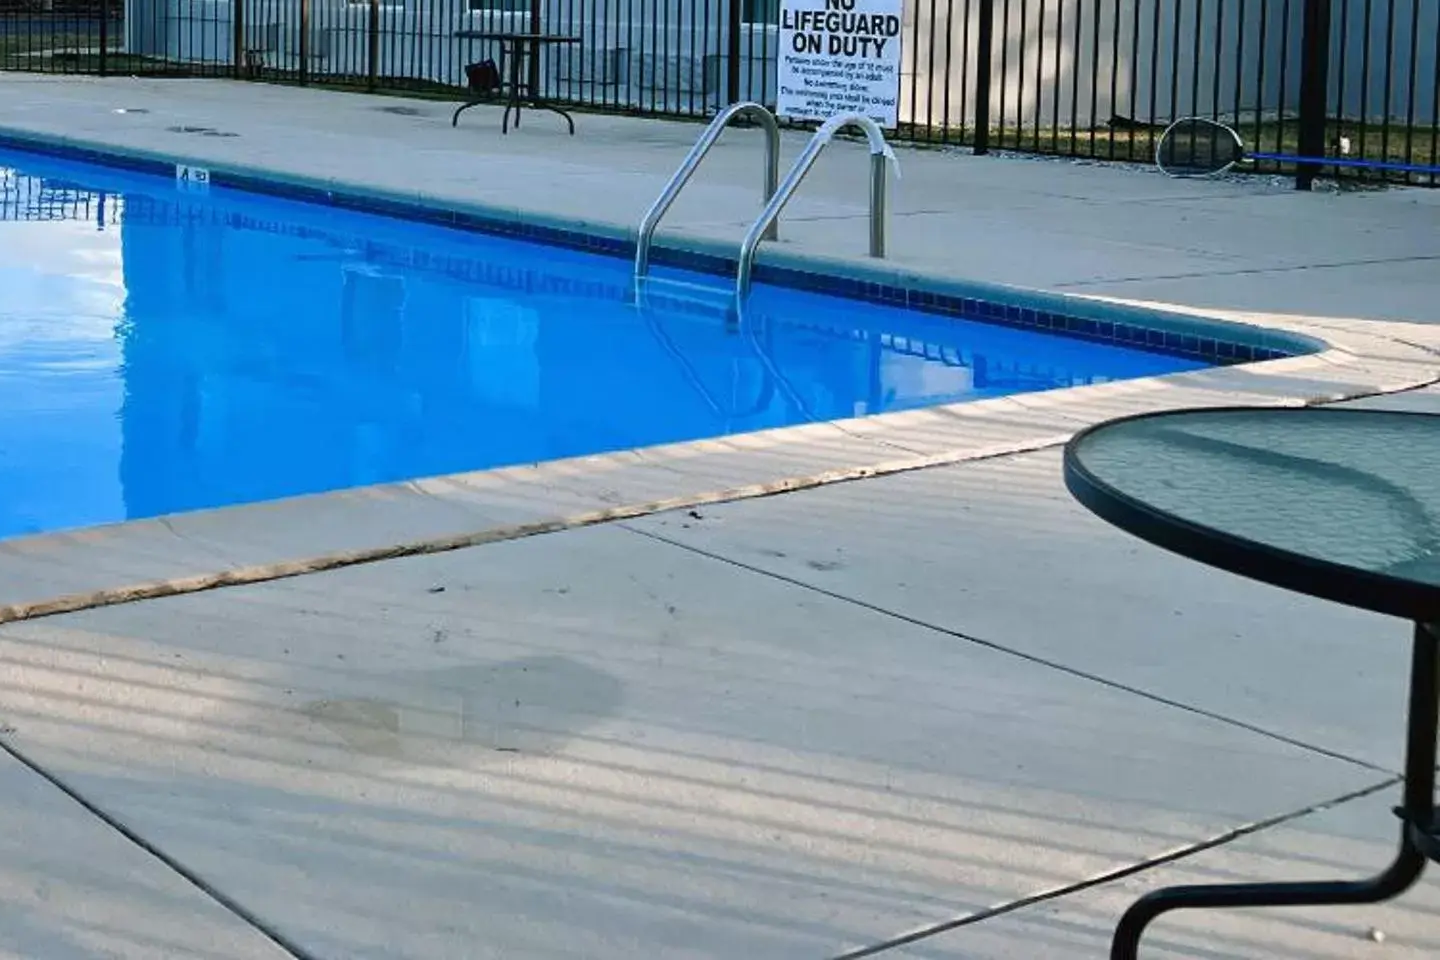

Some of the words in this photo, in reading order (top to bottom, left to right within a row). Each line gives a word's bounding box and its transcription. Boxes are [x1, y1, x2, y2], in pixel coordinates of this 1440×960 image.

[782, 9, 900, 37] LIFEGUARD
[792, 32, 822, 55] ON
[829, 34, 888, 59] DUTY
